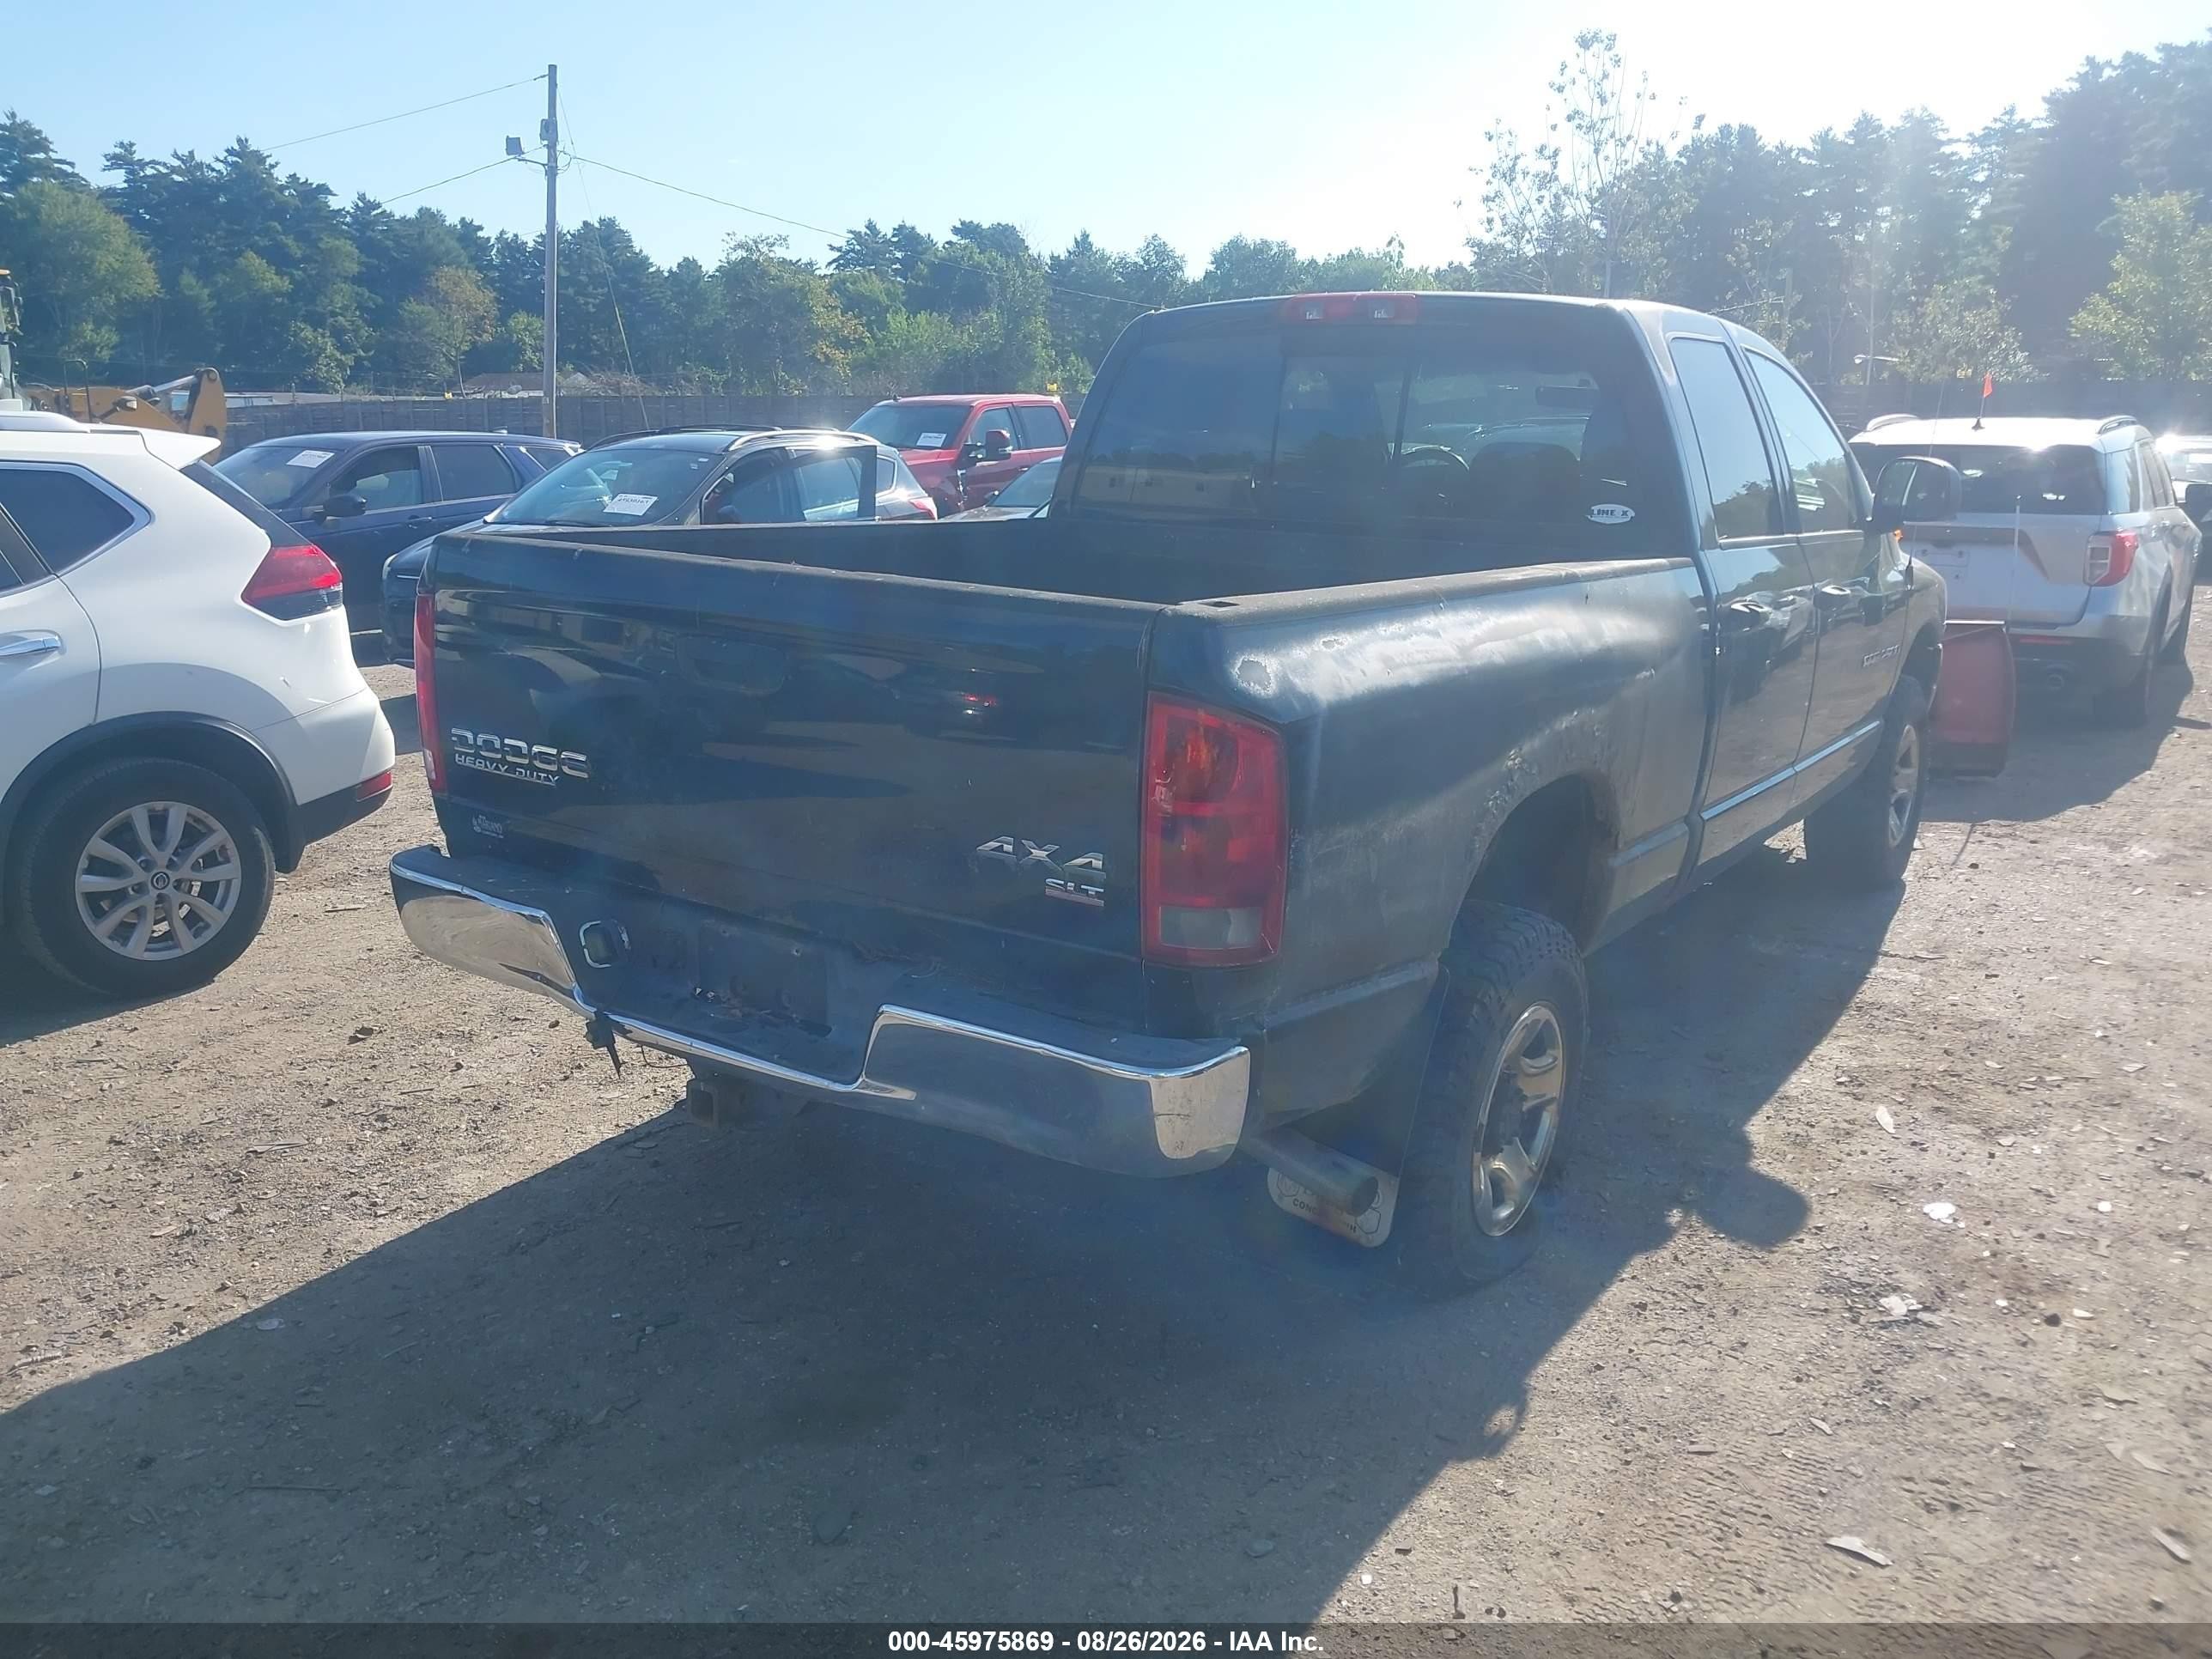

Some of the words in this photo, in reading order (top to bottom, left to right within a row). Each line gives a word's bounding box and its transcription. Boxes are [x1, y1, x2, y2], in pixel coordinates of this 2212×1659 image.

[451, 727, 591, 779] DODGE
[454, 753, 509, 774] HEAVY
[515, 768, 560, 783] DUTY
[975, 836, 1107, 881] 4X4
[1044, 878, 1105, 897] SLT
